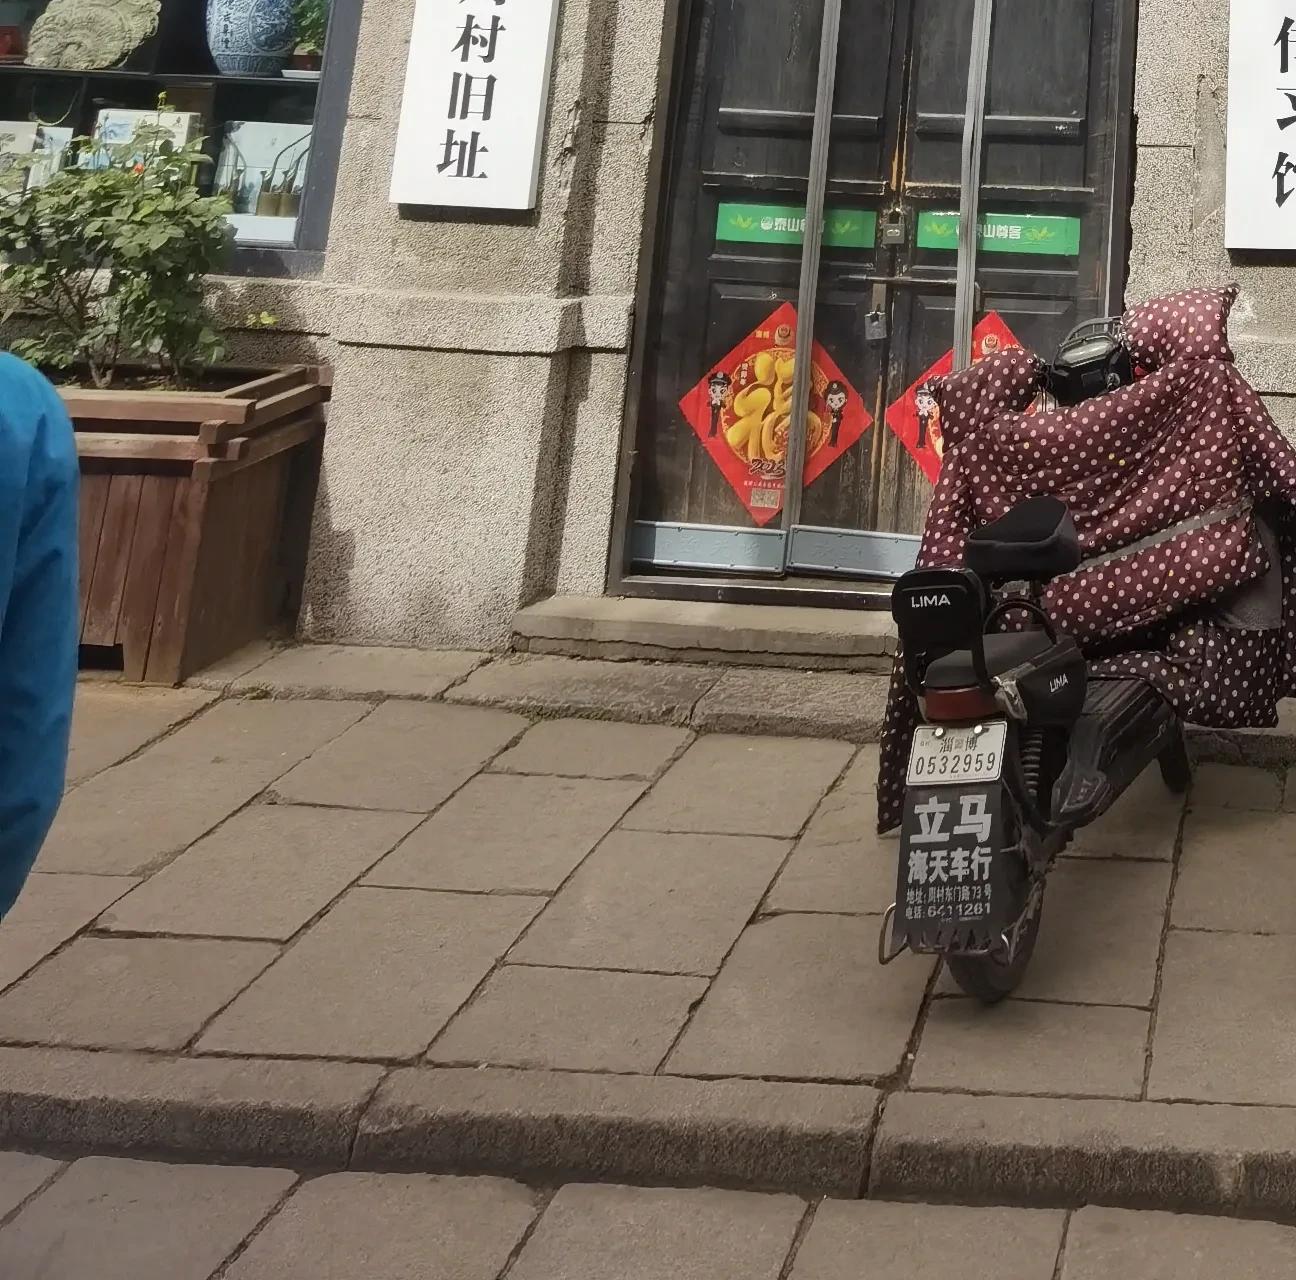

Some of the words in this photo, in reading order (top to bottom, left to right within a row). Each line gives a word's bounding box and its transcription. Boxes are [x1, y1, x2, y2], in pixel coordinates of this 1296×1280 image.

[911, 593, 951, 608] LIMA
[1049, 673, 1069, 693] LIMA
[915, 751, 996, 775] 0532959
[909, 794, 992, 844] 立马
[908, 845, 993, 884] 海天车行
